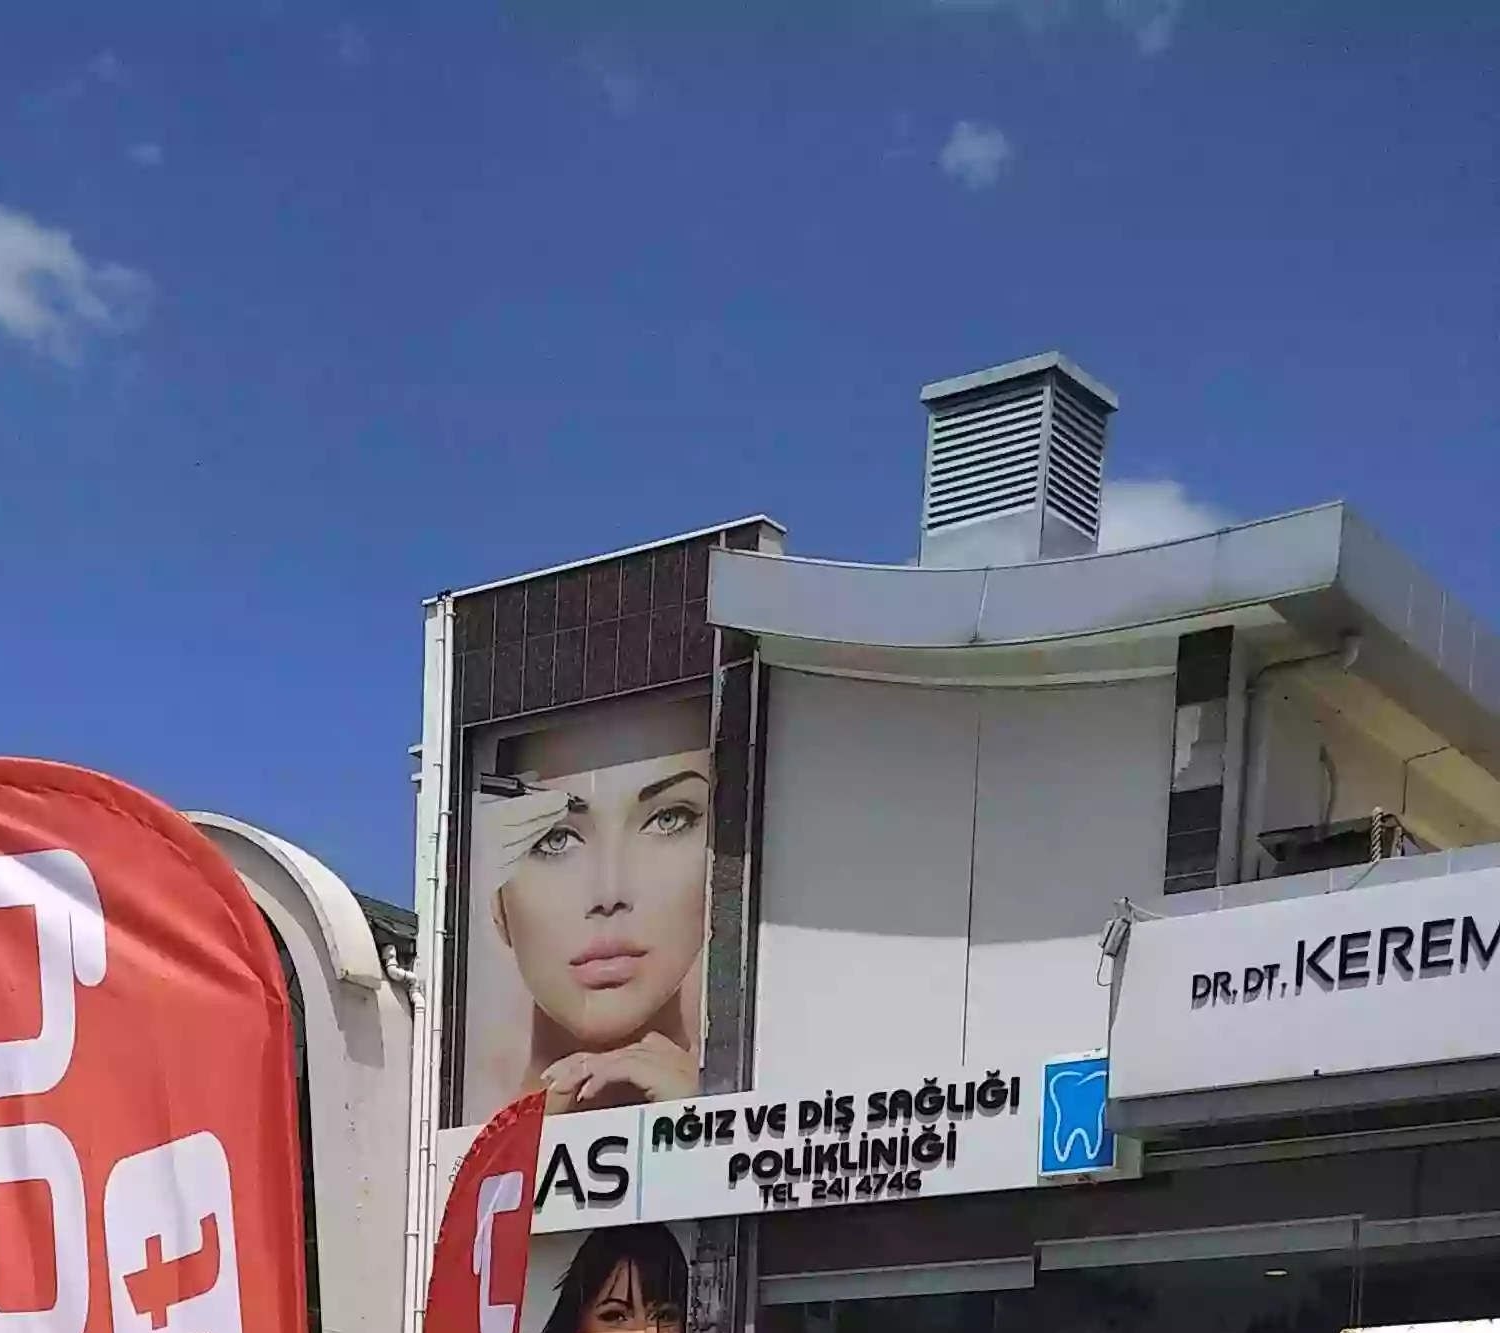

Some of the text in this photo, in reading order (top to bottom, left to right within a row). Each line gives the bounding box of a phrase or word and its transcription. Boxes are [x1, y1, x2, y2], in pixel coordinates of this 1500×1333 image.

[1295, 916, 1500, 992] KEREM
[652, 1070, 1020, 1147] AĞIZ VE DİŞ SAĞLIĞI
[534, 1136, 629, 1209] AS
[729, 1122, 956, 1184] POLİKLİNİĞİ
[759, 1182, 799, 1206] TEL
[856, 1170, 921, 1198] 4746
